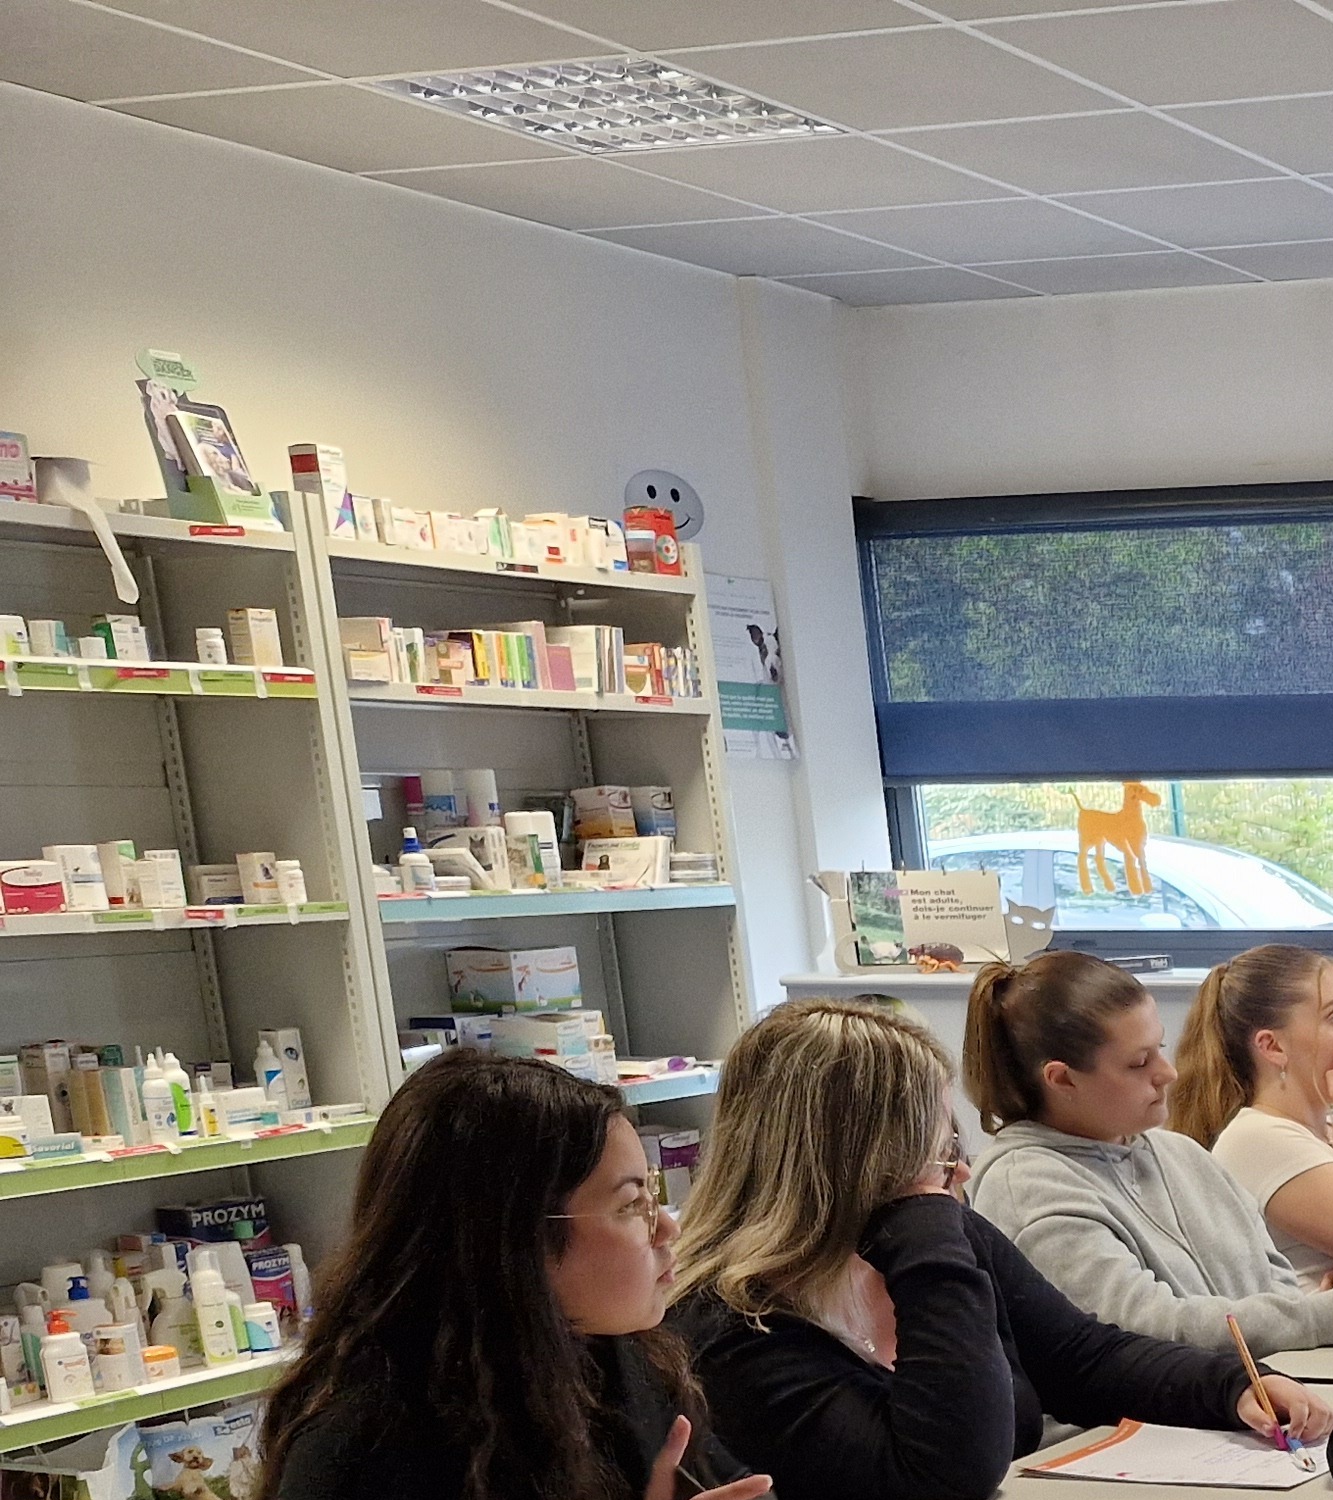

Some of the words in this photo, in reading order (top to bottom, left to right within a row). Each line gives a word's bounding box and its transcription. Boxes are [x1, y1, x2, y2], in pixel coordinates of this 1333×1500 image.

[934, 888, 955, 896] chat
[929, 896, 963, 905] adulte,
[912, 905, 945, 913] dois-je
[948, 904, 994, 912] continuer
[934, 913, 986, 921] vermifuger
[32, 1142, 75, 1152] Savorial
[191, 1202, 266, 1228] PROZYM
[251, 1255, 289, 1271] PROZYM
